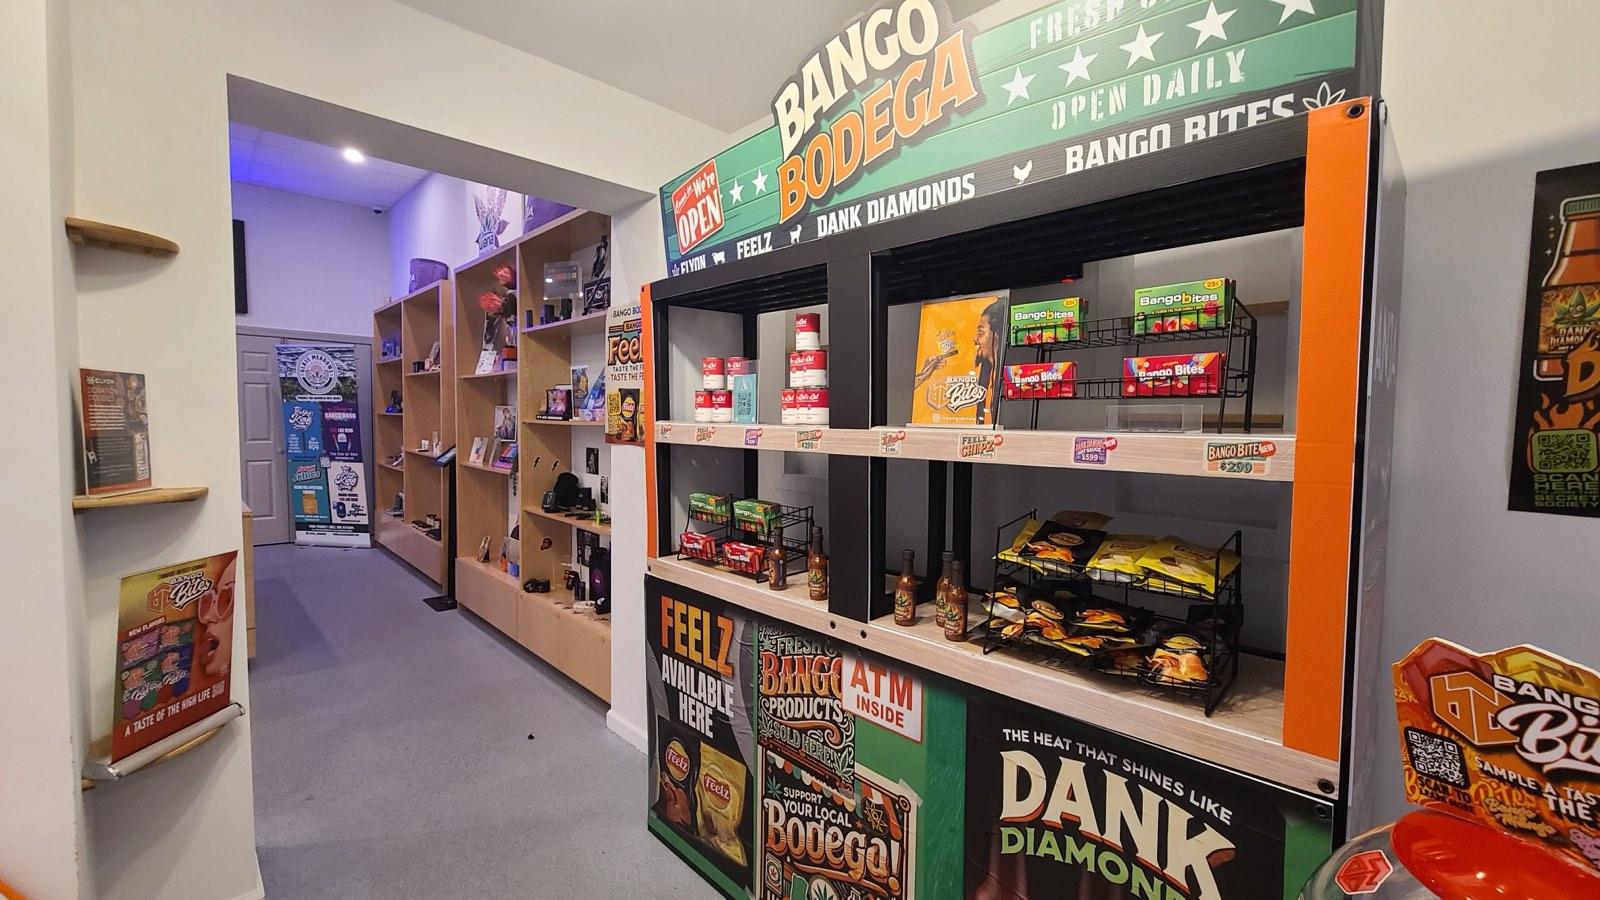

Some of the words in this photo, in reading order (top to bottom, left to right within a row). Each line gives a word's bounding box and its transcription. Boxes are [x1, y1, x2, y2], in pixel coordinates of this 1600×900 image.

[774, 0, 939, 160] BANGO
[1051, 82, 1127, 131] OPEN
[1143, 48, 1246, 106] DAILY
[777, 29, 977, 224] BODEGA
[1065, 123, 1170, 175] BANGO
[693, 172, 715, 199] We're
[679, 189, 721, 248] OPEN
[817, 207, 862, 238] DANK
[867, 172, 976, 223] DIAMONDS
[736, 232, 772, 260] FEELZ
[611, 373, 628, 381] TASTE
[628, 372, 638, 381] THE
[1041, 368, 1063, 381] Bites
[1175, 363, 1205, 376] Bites
[1081, 453, 1099, 461] $599
[1208, 445, 1236, 460] BANGO
[1534, 473, 1599, 482] SCAN
[1534, 481, 1599, 490] HERE
[661, 595, 733, 677] FEELZ
[777, 636, 822, 656] FRESH
[662, 654, 734, 718] AVAILABLE
[851, 659, 913, 711] ATM
[125, 725, 131, 737] A
[133, 714, 155, 732] TASTE
[156, 709, 165, 722] OF
[167, 702, 180, 717] THE
[181, 694, 197, 711] HIGH
[198, 688, 211, 703] LIFE
[679, 691, 714, 739] HERE
[768, 698, 843, 723] PRODUCTS
[856, 694, 904, 728] INSIDE
[773, 722, 801, 749] SOLD
[668, 751, 689, 772] Feelz
[705, 777, 730, 800] Feelz
[1003, 728, 1030, 743] THE
[1034, 731, 1072, 751] HEAT
[1076, 742, 1117, 766] THAT
[1123, 758, 1185, 797] SHINES
[1189, 789, 1233, 826] LIKE
[1474, 756, 1538, 790] SAMPLE
[1545, 782, 1557, 795] A
[1562, 787, 1600, 806] TAS
[783, 787, 823, 805] SUPPORT
[1542, 793, 1593, 822] THE
[784, 799, 813, 818] YOUR
[815, 805, 852, 828] LOCAL
[1000, 750, 1237, 900] DANK
